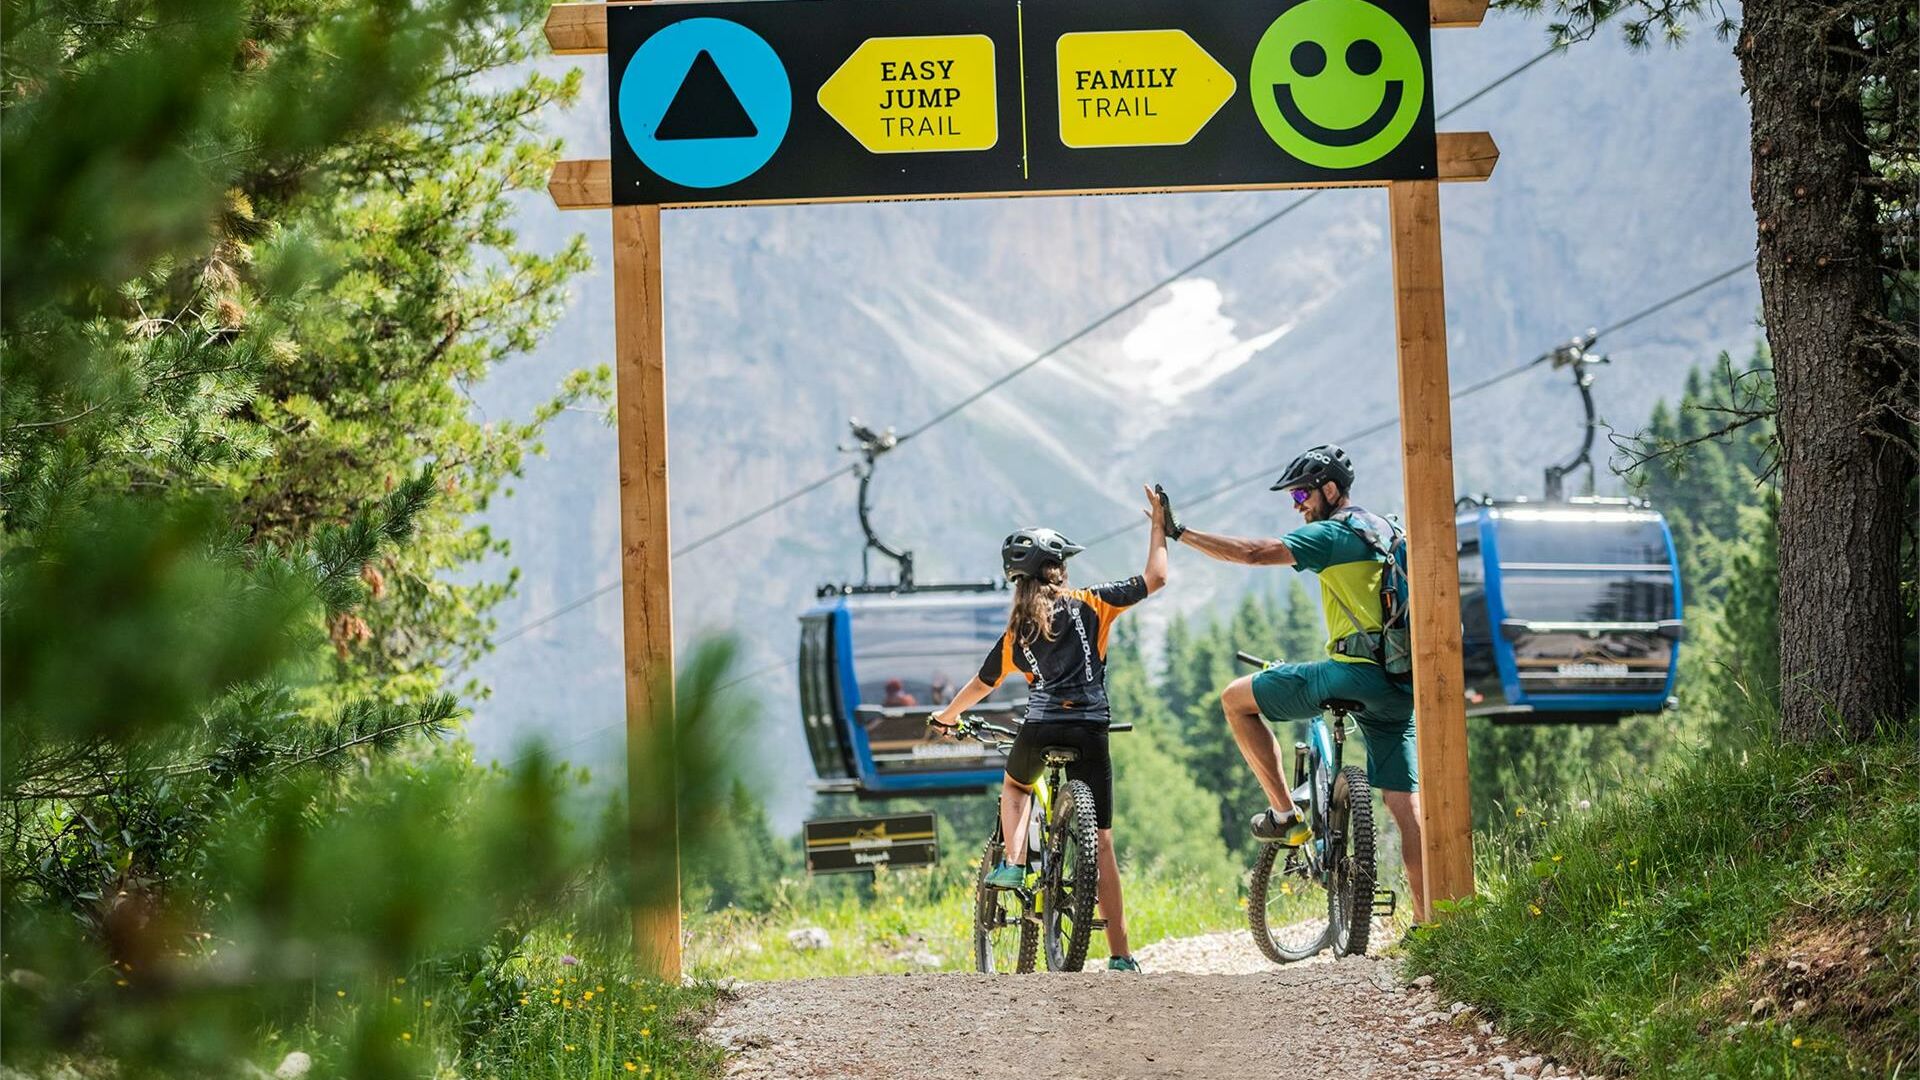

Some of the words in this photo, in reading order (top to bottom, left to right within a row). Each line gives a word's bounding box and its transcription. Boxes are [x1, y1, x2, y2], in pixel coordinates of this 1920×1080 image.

[881, 60, 954, 81] EASY
[1075, 67, 1178, 90] FAMILY
[880, 88, 961, 109] JUMP
[1077, 96, 1158, 118] TRAIL
[880, 116, 961, 137] TRAIL
[1304, 451, 1331, 465] POC
[1071, 607, 1094, 682] cannondale
